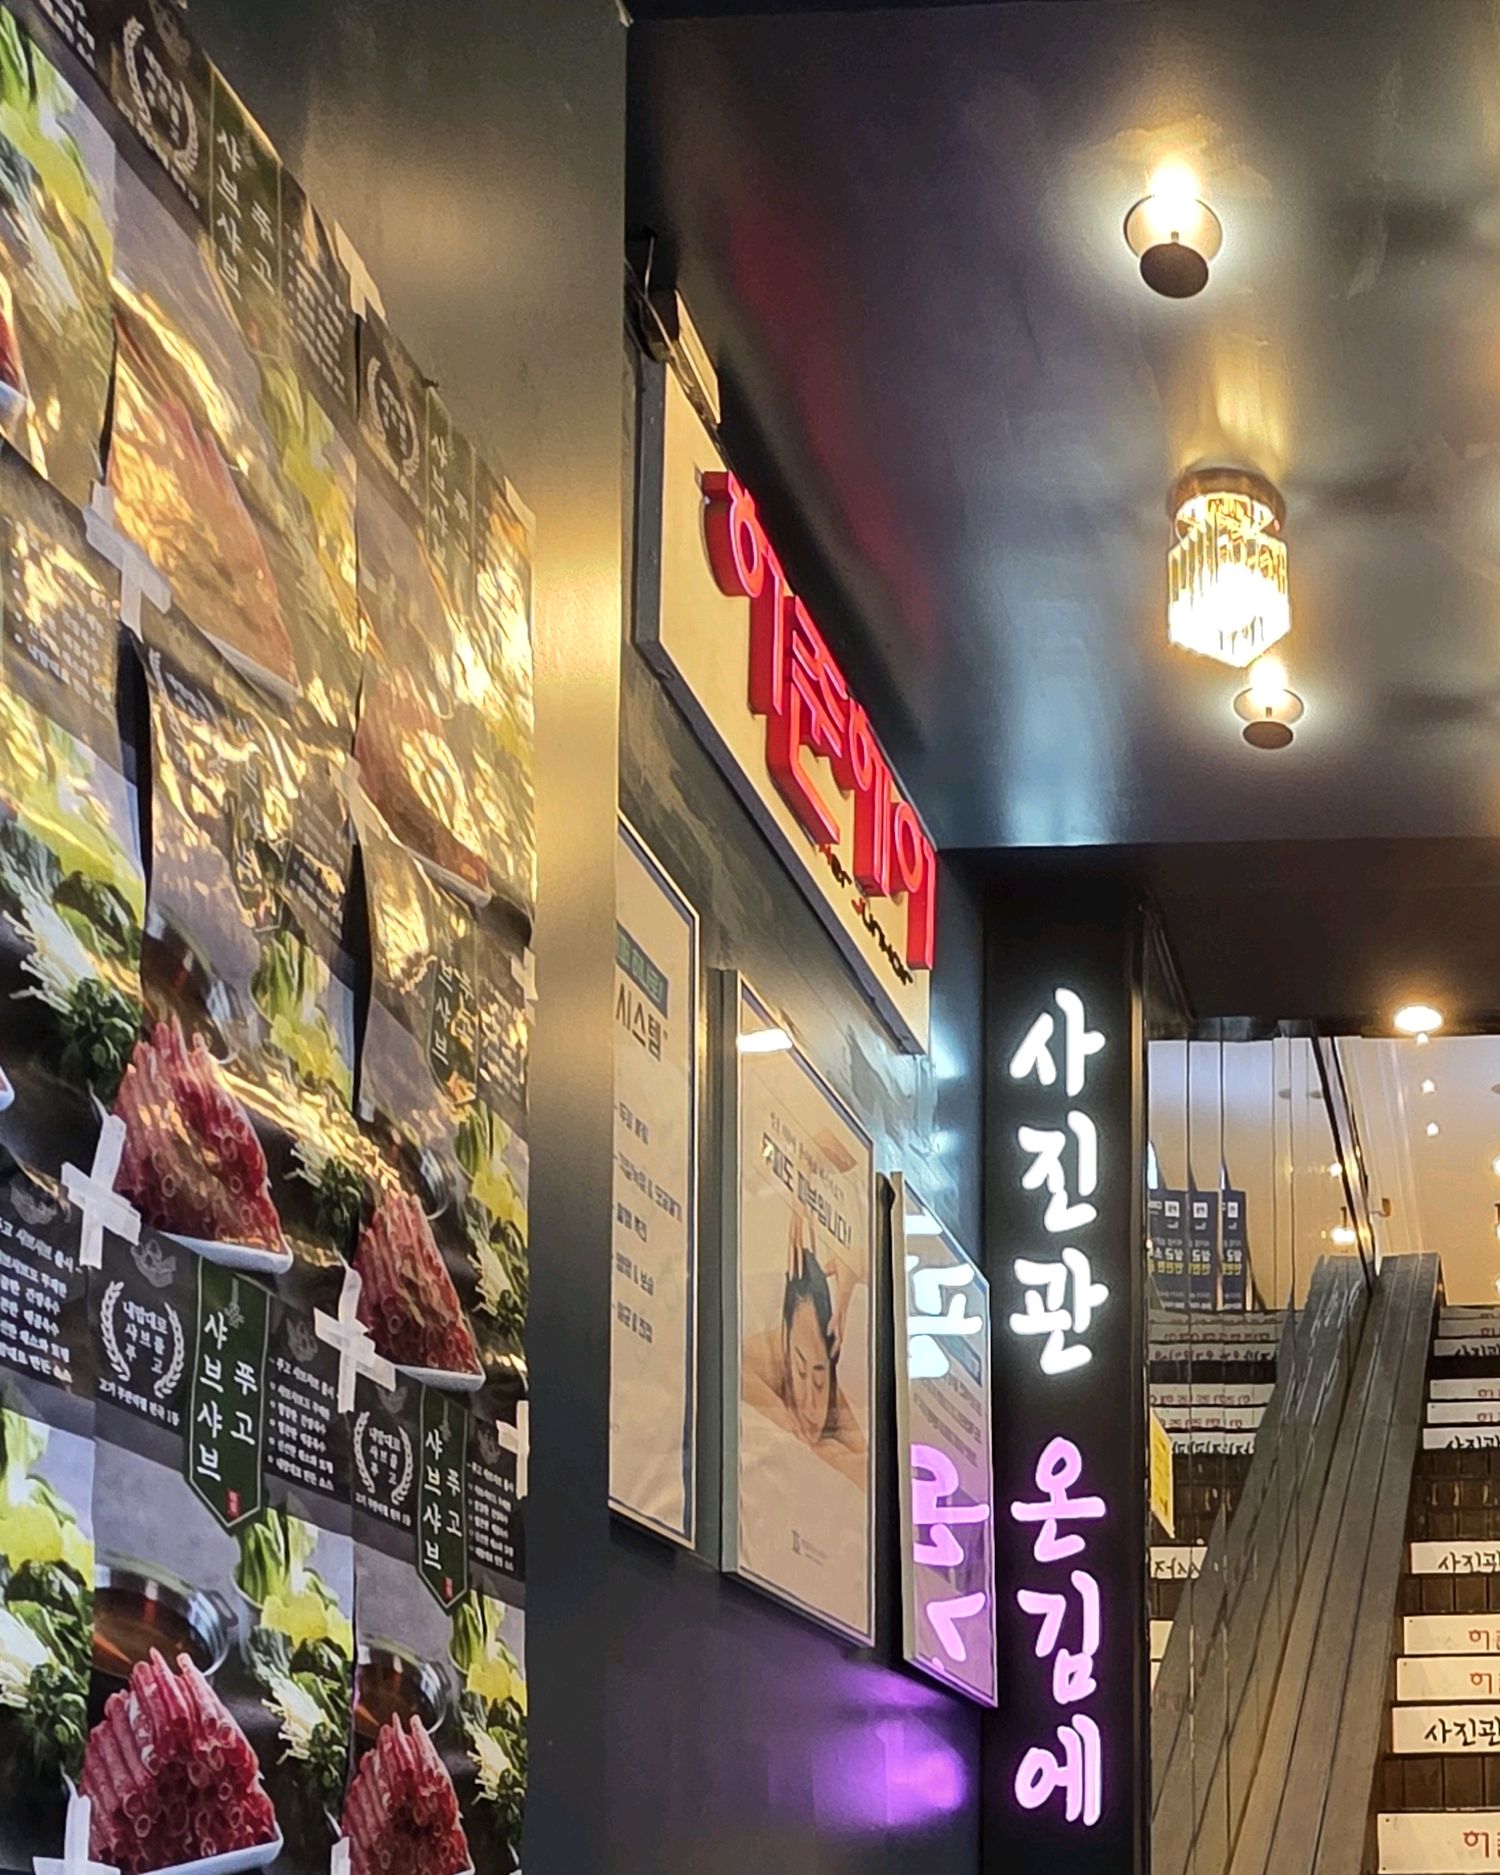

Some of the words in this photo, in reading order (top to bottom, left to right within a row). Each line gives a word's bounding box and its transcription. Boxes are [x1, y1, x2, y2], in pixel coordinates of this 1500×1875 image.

[1009, 987, 1110, 1376] 사진관
[196, 1310, 229, 1482] 샤브샤브
[230, 1359, 259, 1447] 푸고
[422, 1428, 444, 1571] 샤브샤브
[445, 1467, 463, 1538] 푸고
[1010, 1436, 1107, 1826] 온김에
